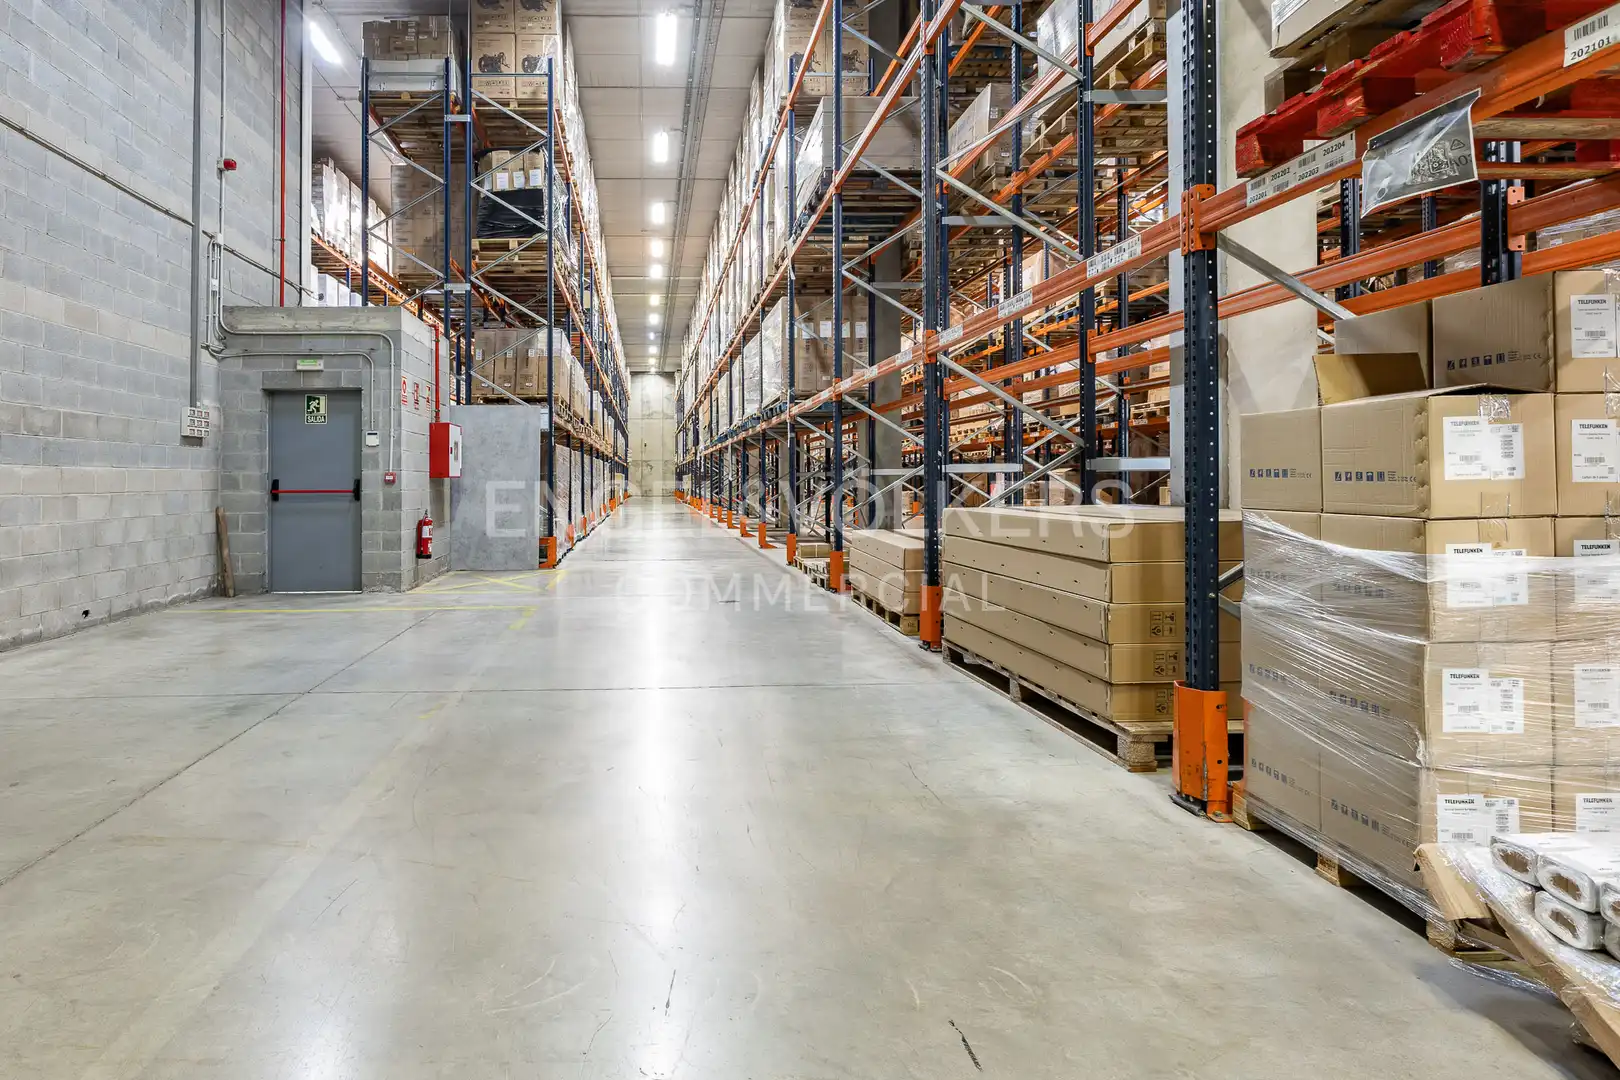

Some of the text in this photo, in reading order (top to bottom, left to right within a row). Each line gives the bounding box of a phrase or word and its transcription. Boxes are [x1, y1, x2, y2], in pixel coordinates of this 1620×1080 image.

[1570, 35, 1612, 61] 202101
[1322, 140, 1346, 157] 202204
[307, 415, 325, 423] SALIDA
[1444, 797, 1475, 805] TELEFUNKEN
